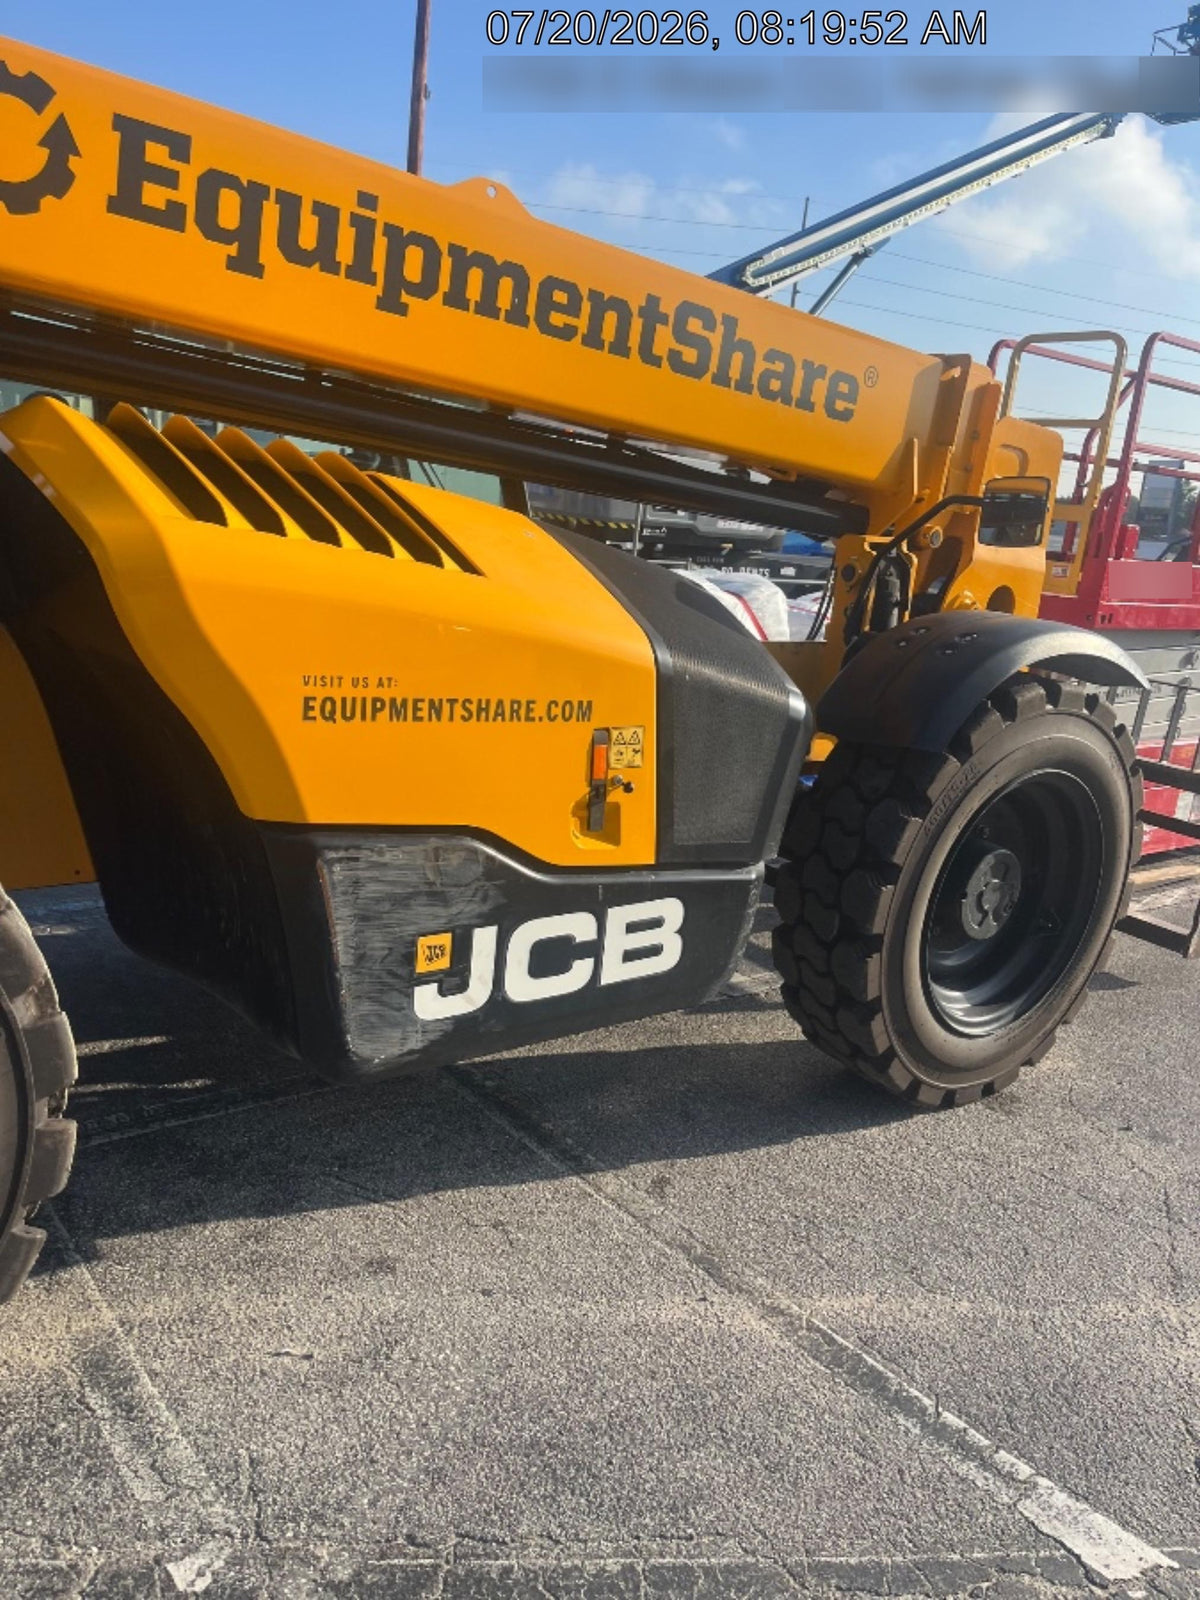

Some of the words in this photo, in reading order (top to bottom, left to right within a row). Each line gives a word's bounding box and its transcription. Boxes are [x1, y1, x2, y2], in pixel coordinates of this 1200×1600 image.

[302, 675, 344, 688] VISIT
[351, 677, 369, 689] US
[376, 677, 398, 689] AT:
[302, 695, 593, 724] EQUIPMENTSHARE.COM
[413, 897, 685, 1021] JCB
